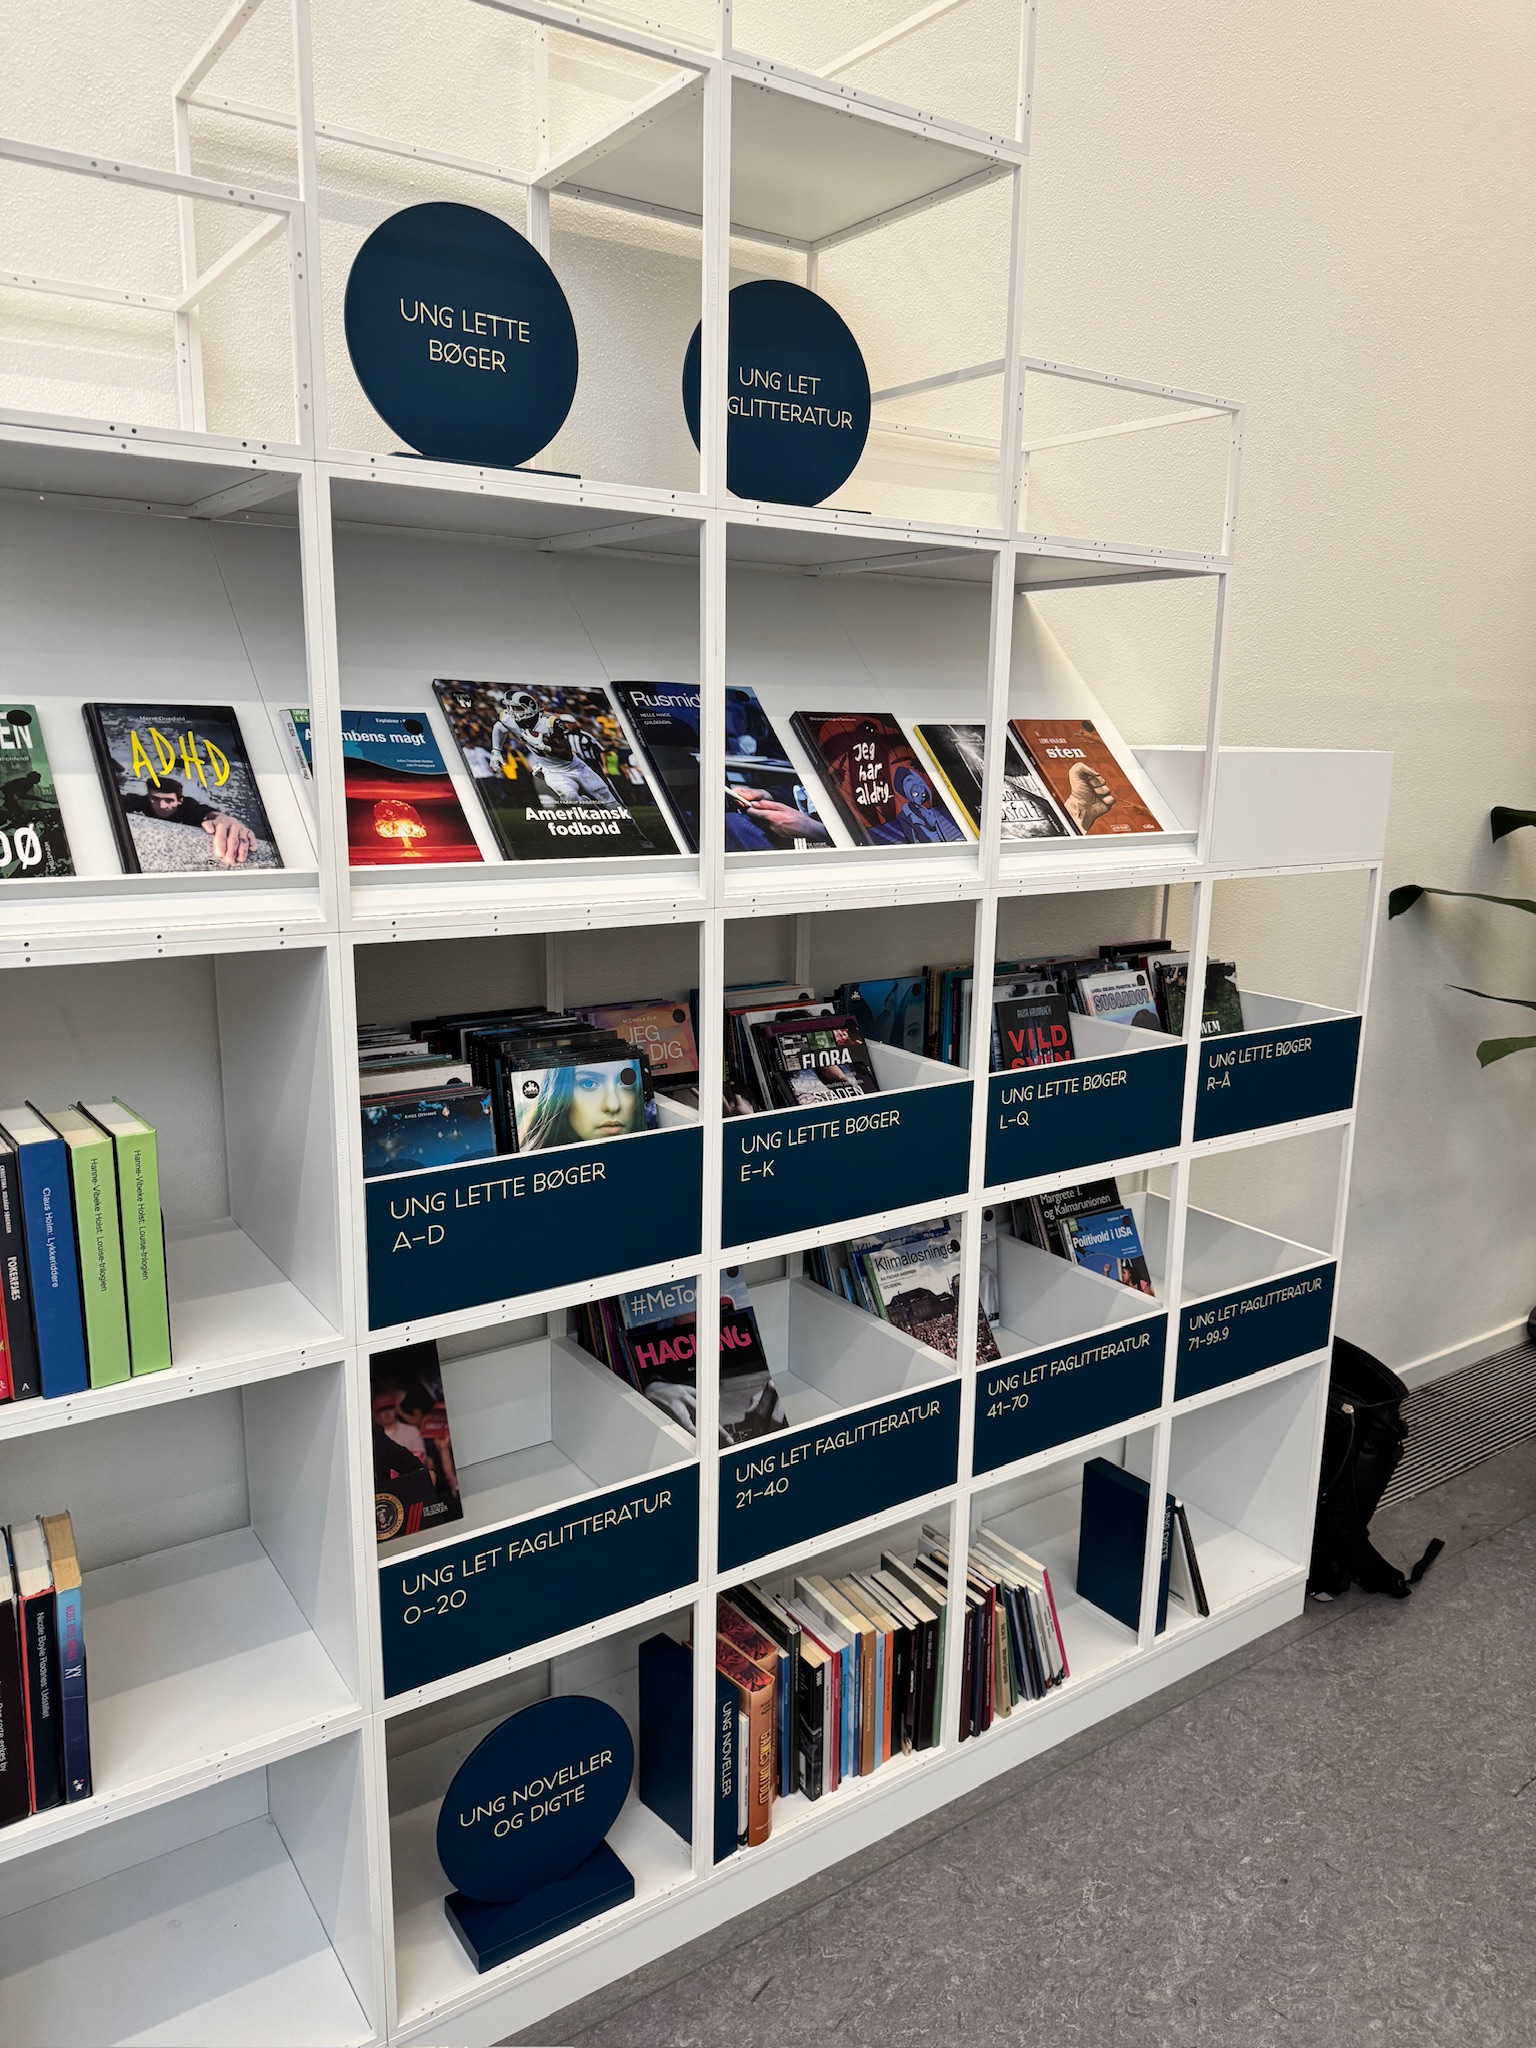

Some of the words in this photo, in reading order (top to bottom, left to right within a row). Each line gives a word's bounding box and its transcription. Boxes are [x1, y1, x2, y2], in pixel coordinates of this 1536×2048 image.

[400, 297, 453, 329] UNG
[462, 310, 531, 343] LETTE
[428, 339, 507, 373] BØGER
[738, 366, 782, 390] UNG
[788, 373, 821, 396] LET
[727, 396, 854, 430] GLITTERATUR
[629, 691, 701, 709] Rusmid
[0, 711, 33, 750] EN
[305, 729, 387, 744] Ambens
[390, 733, 427, 747] magt
[130, 727, 230, 788] ADHD
[852, 741, 876, 762] Jeg
[1045, 745, 1087, 759] sten
[858, 762, 883, 782] har
[525, 806, 633, 821] Amerikansk
[547, 821, 622, 836] fodbold
[1092, 988, 1152, 1012] SUGARBOY
[625, 1024, 661, 1045] JEG
[1007, 1024, 1068, 1053] VILD
[649, 1040, 684, 1061] DIG
[1208, 1050, 1238, 1070] UNG
[1238, 1042, 1274, 1065] LETTE
[1275, 1037, 1313, 1058] BØGER
[1001, 1085, 1034, 1106] UNG
[1037, 1076, 1080, 1100] LETTE
[1082, 1069, 1128, 1092] BØGER
[741, 1131, 783, 1155] UNG
[788, 1120, 841, 1146] LETTE
[845, 1109, 901, 1136] BØGER
[89, 1158, 102, 1212] Hanne-Vibeke
[134, 1149, 146, 1202] Hanne-Vibeke
[390, 1192, 446, 1220] UNG
[455, 1176, 526, 1208] LETTE
[533, 1162, 607, 1192] BØGER
[42, 1187, 52, 1211] Claus
[1040, 1188, 1075, 1205] Margrete
[1043, 1209, 1055, 1220] og
[1055, 1194, 1111, 1216] Kalmarunionen
[44, 1212, 54, 1236] Holm:
[94, 1213, 104, 1235] Holst:
[137, 1203, 147, 1225] Holst:
[1072, 1230, 1108, 1248] Politivold
[1110, 1230, 1115, 1240] i
[1115, 1226, 1133, 1239] USA
[46, 1237, 59, 1289] Lykkeriddere
[96, 1236, 109, 1293] Louise-trilogien
[138, 1225, 150, 1281] Louise-trilogien
[874, 1241, 957, 1272] Klimaløsninge
[1188, 1312, 1216, 1332] UNG
[1216, 1303, 1238, 1323] LET
[1239, 1276, 1323, 1316] FAGLITTERATUR
[634, 1325, 752, 1369] HACNG
[987, 1375, 1019, 1397] UNG
[1022, 1363, 1047, 1388] LET
[1049, 1332, 1151, 1378] FAGLITTERATUR
[736, 1455, 775, 1483] UNG
[780, 1443, 811, 1469] LET
[815, 1400, 941, 1457] FAGLITTERATUR
[402, 1564, 455, 1596] UNG
[462, 1547, 502, 1577] LET
[508, 1490, 672, 1562] FAGLITTERATUR
[36, 1611, 47, 1636] Nicole
[37, 1636, 48, 1658] Boyle
[64, 1664, 82, 1680] XY
[721, 1701, 732, 1732] UNG
[721, 1734, 732, 1798] NOVELLER
[460, 1795, 505, 1827] UNG
[512, 1750, 613, 1806] NOVELLER
[494, 1812, 523, 1838] OG
[530, 1783, 586, 1822] DIGTE
